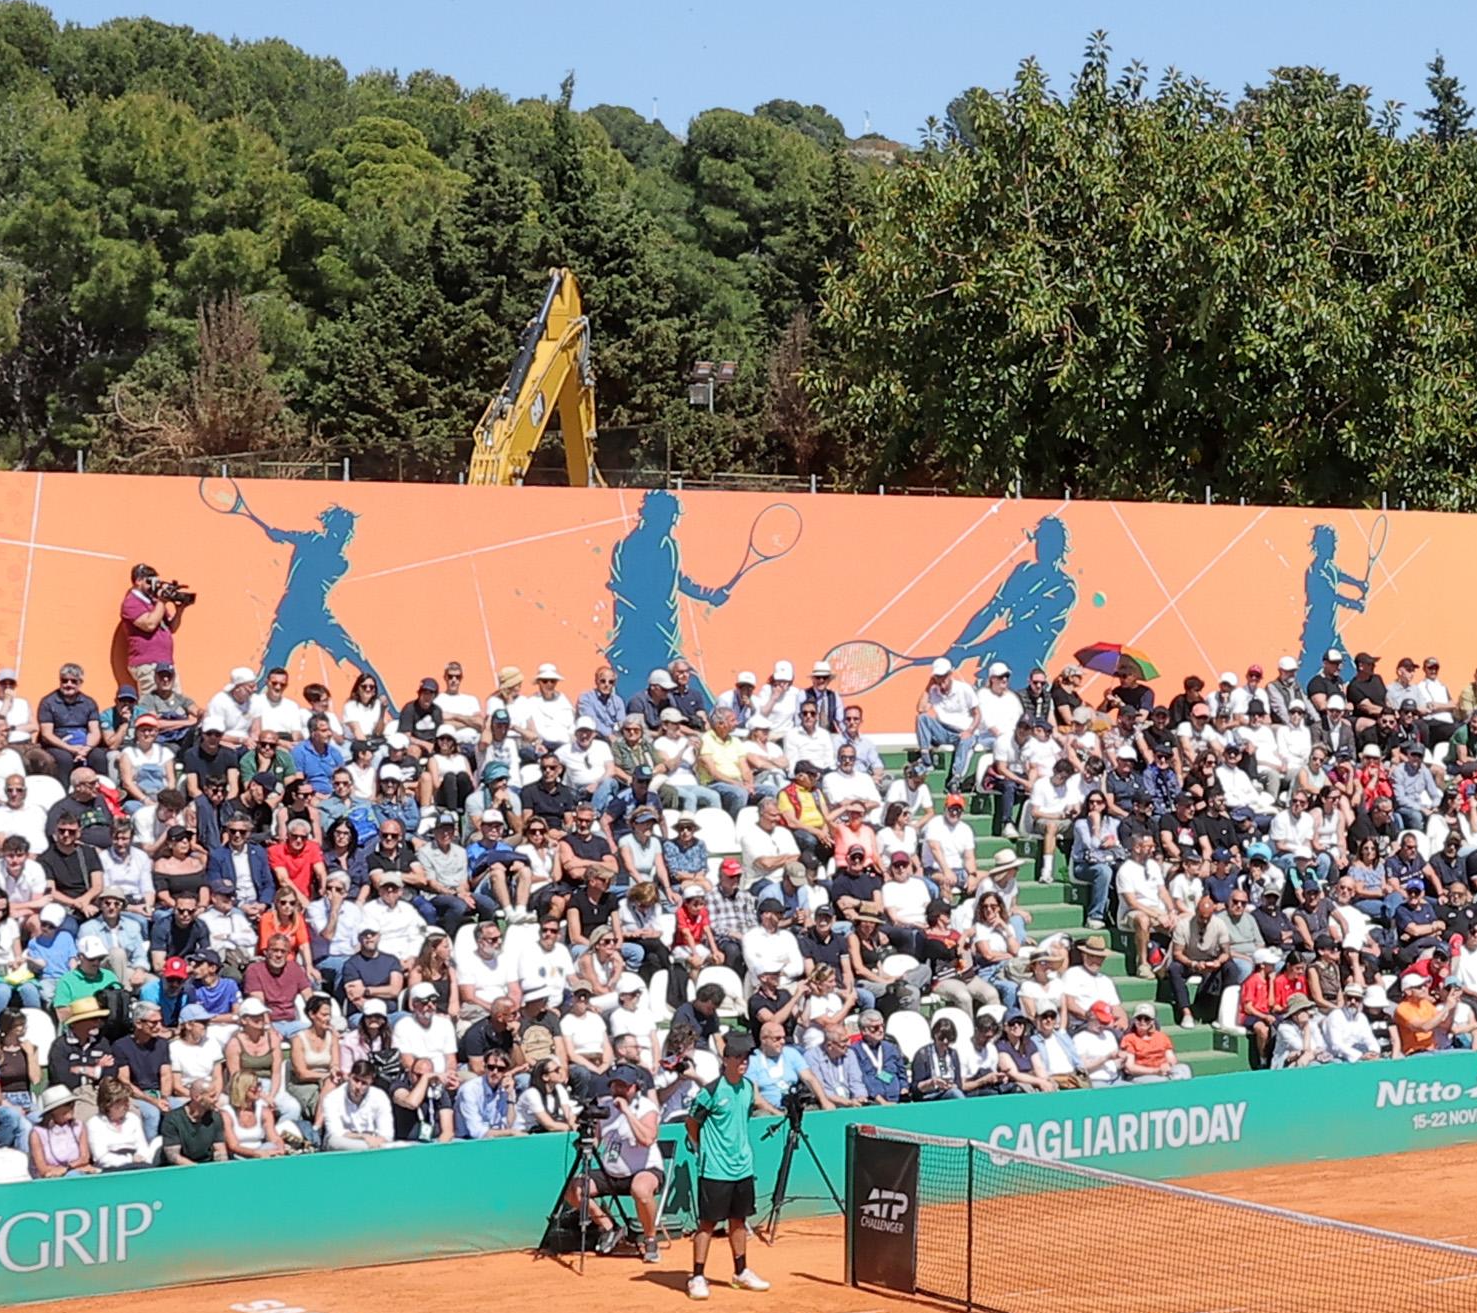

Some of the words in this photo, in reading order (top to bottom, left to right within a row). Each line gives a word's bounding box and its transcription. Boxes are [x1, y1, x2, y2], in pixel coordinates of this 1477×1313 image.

[1376, 1078, 1462, 1108] Nitto
[988, 1101, 1248, 1166] CAGLIARITODAY
[1412, 1111, 1448, 1130] 15-22
[860, 1188, 909, 1221] ATP
[860, 1215, 904, 1235] CHALLENGER
